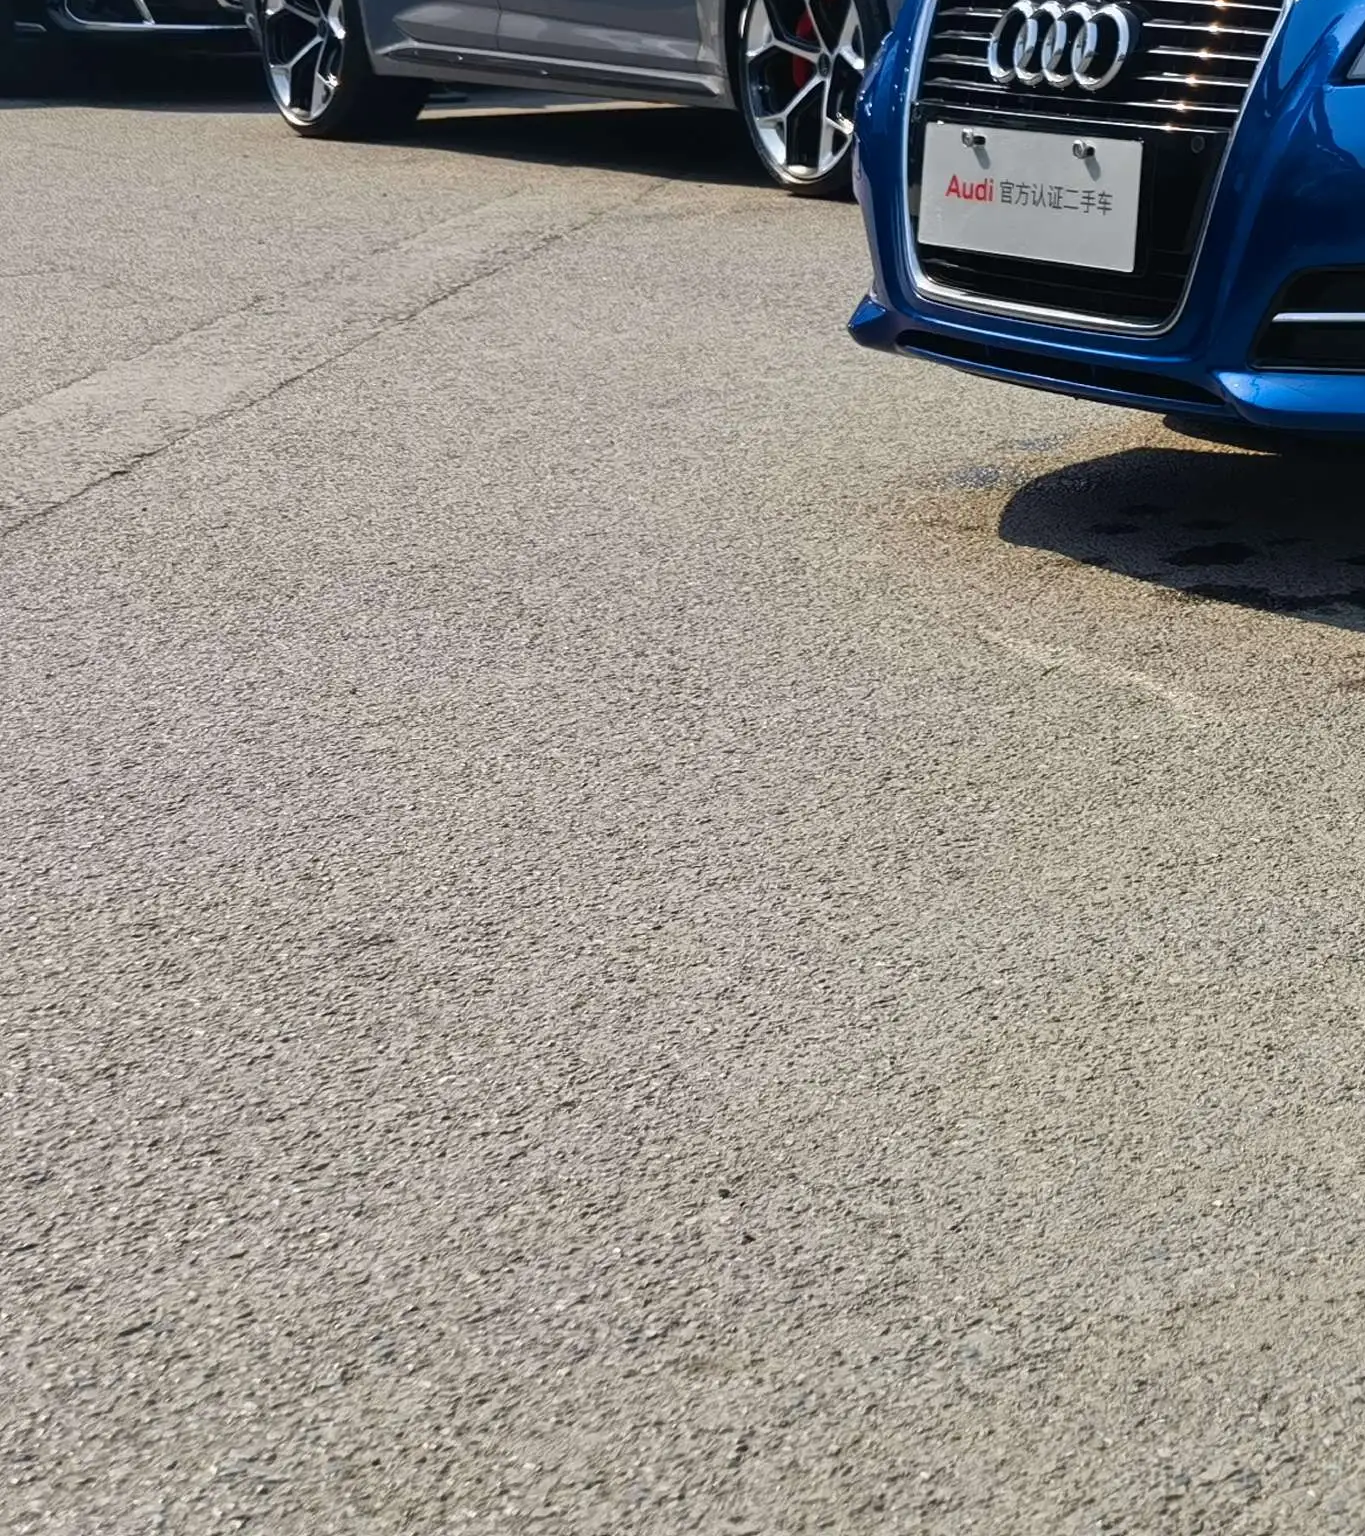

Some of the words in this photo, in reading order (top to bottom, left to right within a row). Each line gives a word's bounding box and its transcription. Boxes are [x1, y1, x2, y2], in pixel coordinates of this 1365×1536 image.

[945, 174, 994, 202] Audi
[1000, 179, 1113, 215] 官方认证二手车
